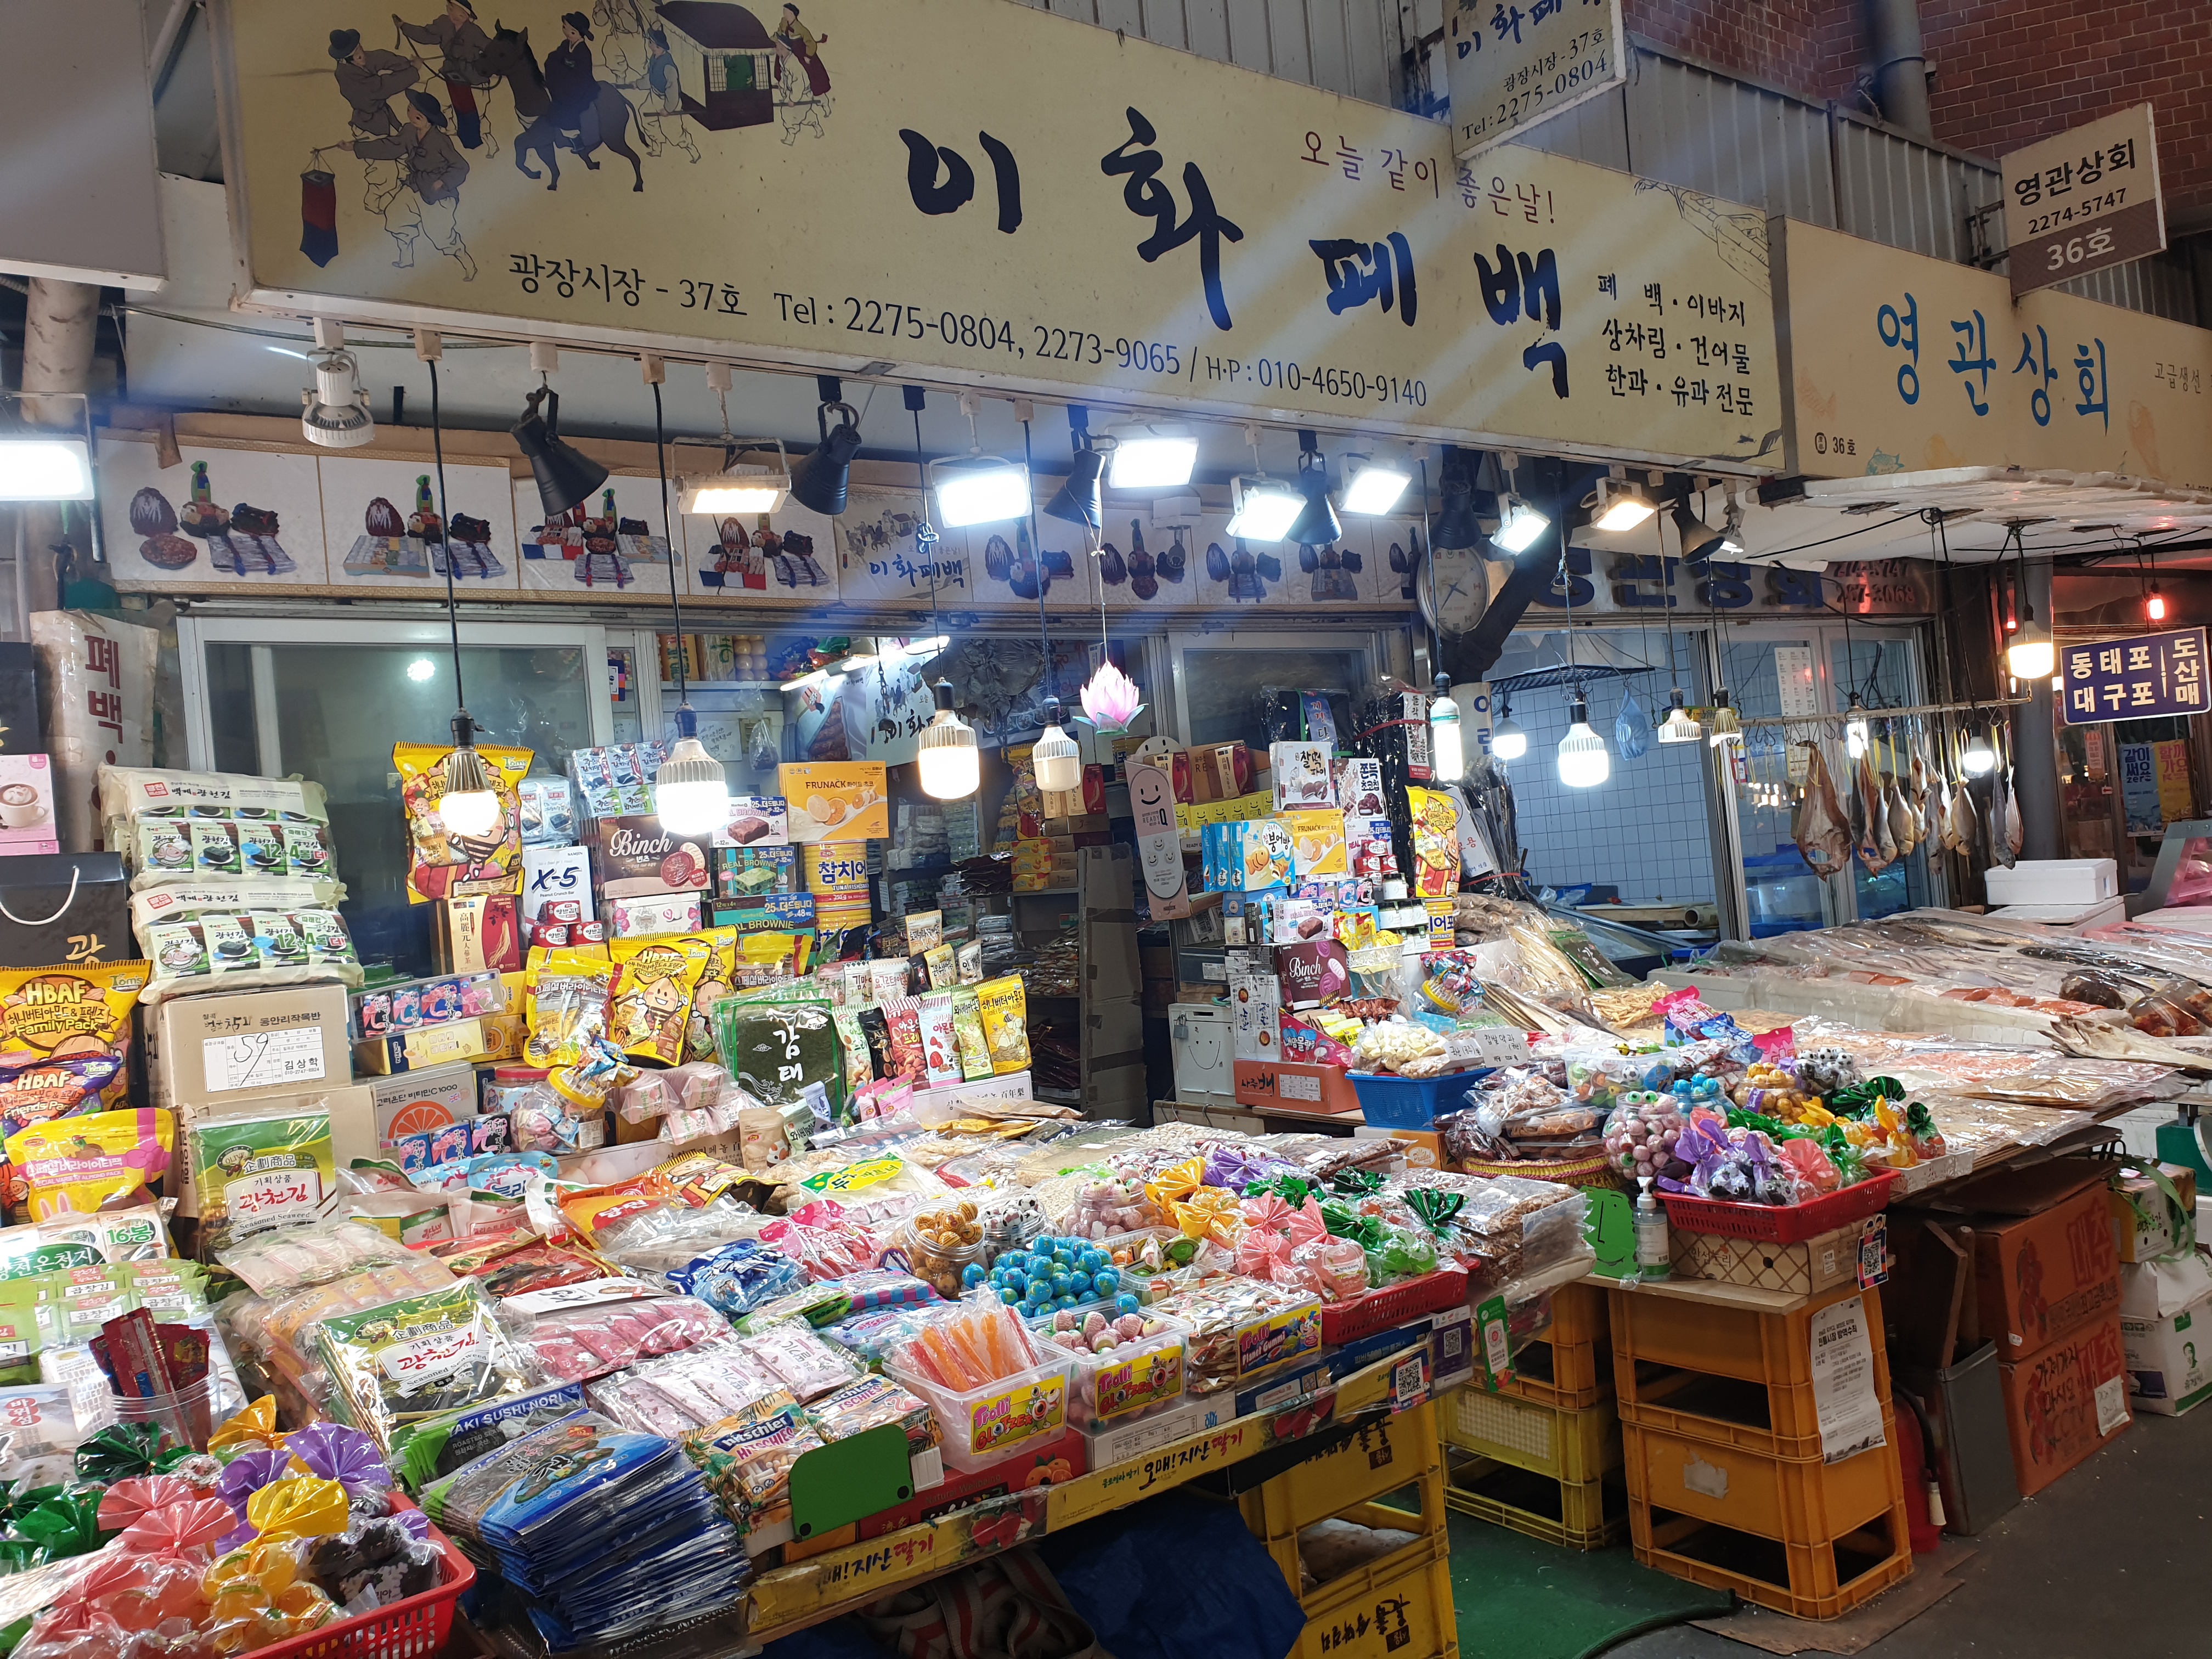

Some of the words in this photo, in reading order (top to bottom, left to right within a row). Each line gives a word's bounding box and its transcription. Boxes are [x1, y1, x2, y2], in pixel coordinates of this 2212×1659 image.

[1497, 49, 1607, 126] 2275-0804
[1301, 131, 1364, 181] 오늘
[1381, 148, 1441, 200] 같이
[1457, 166, 1555, 224] 좋은날!
[2014, 138, 2136, 206] 영관상회
[2028, 188, 2128, 235] 2274-5747
[2046, 227, 2115, 271] 36호
[509, 254, 645, 307] 광장시장
[679, 279, 747, 315] 37호
[845, 297, 1024, 359] 2275-0804,
[1035, 326, 1181, 376] 2273-9065
[1259, 358, 1427, 407] 010-4650-9140
[1877, 292, 2109, 436] 영관상회
[2154, 362, 2201, 394] 고급생선
[1717, 383, 1753, 416] 전문
[2070, 646, 2153, 680] 동태포
[2074, 683, 2155, 713] 대구포
[1300, 750, 1322, 769] 찰떡
[2123, 747, 2150, 763] 같이
[1311, 766, 1327, 776] 파이
[2126, 762, 2151, 776] 써요
[805, 780, 846, 789] FRUNACK
[1361, 780, 1380, 792] 초코칩
[736, 808, 771, 818] BROWNIE
[1143, 815, 1160, 823] READY
[610, 830, 674, 857] Binch
[1268, 832, 1291, 853] 붕어빵
[722, 861, 743, 870] REAL
[744, 860, 777, 868] BROWNIE
[531, 867, 582, 891] X-5
[747, 919, 795, 930] BROWNIE
[1289, 955, 1323, 978] Binch
[25, 980, 86, 1006] HBAF
[981, 990, 1024, 1011] 허니버터아몬드
[14, 1021, 64, 1037] Family
[65, 1019, 99, 1031] Pack
[259, 1012, 321, 1026] 동안리작목반
[284, 1057, 318, 1070] 김상학
[773, 1026, 804, 1082] 감태
[16, 1071, 72, 1092] HBAF
[3, 1102, 47, 1120] Friends
[255, 1174, 292, 1187] 기획상품
[239, 1183, 308, 1212] 광천김
[239, 1215, 276, 1231] Seasoned
[278, 1211, 311, 1221] Seaweed
[106, 1224, 154, 1246] 16봉
[410, 1334, 455, 1351] 기획상품
[1239, 1322, 1271, 1352] Trolli
[1242, 1345, 1262, 1367] Planet
[1263, 1331, 1286, 1353] Gummi
[407, 1367, 449, 1387] Seasoned
[1098, 1363, 1133, 1393] Trolli
[445, 1417, 480, 1438] YAKI
[528, 1392, 563, 1409] NORI
[973, 1396, 1012, 1428] Trolli
[452, 1434, 483, 1450] ROASTED
[721, 1415, 788, 1447] hitschler
[736, 1426, 797, 1460] HITSCHIES
[1179, 1441, 1211, 1465] 지산
[1211, 1427, 1244, 1457] 딸기
[926, 1487, 957, 1505] Natural
[958, 1474, 1002, 1493] Wellbeing
[851, 1547, 893, 1578] 지산
[894, 1533, 934, 1567] 딸기
